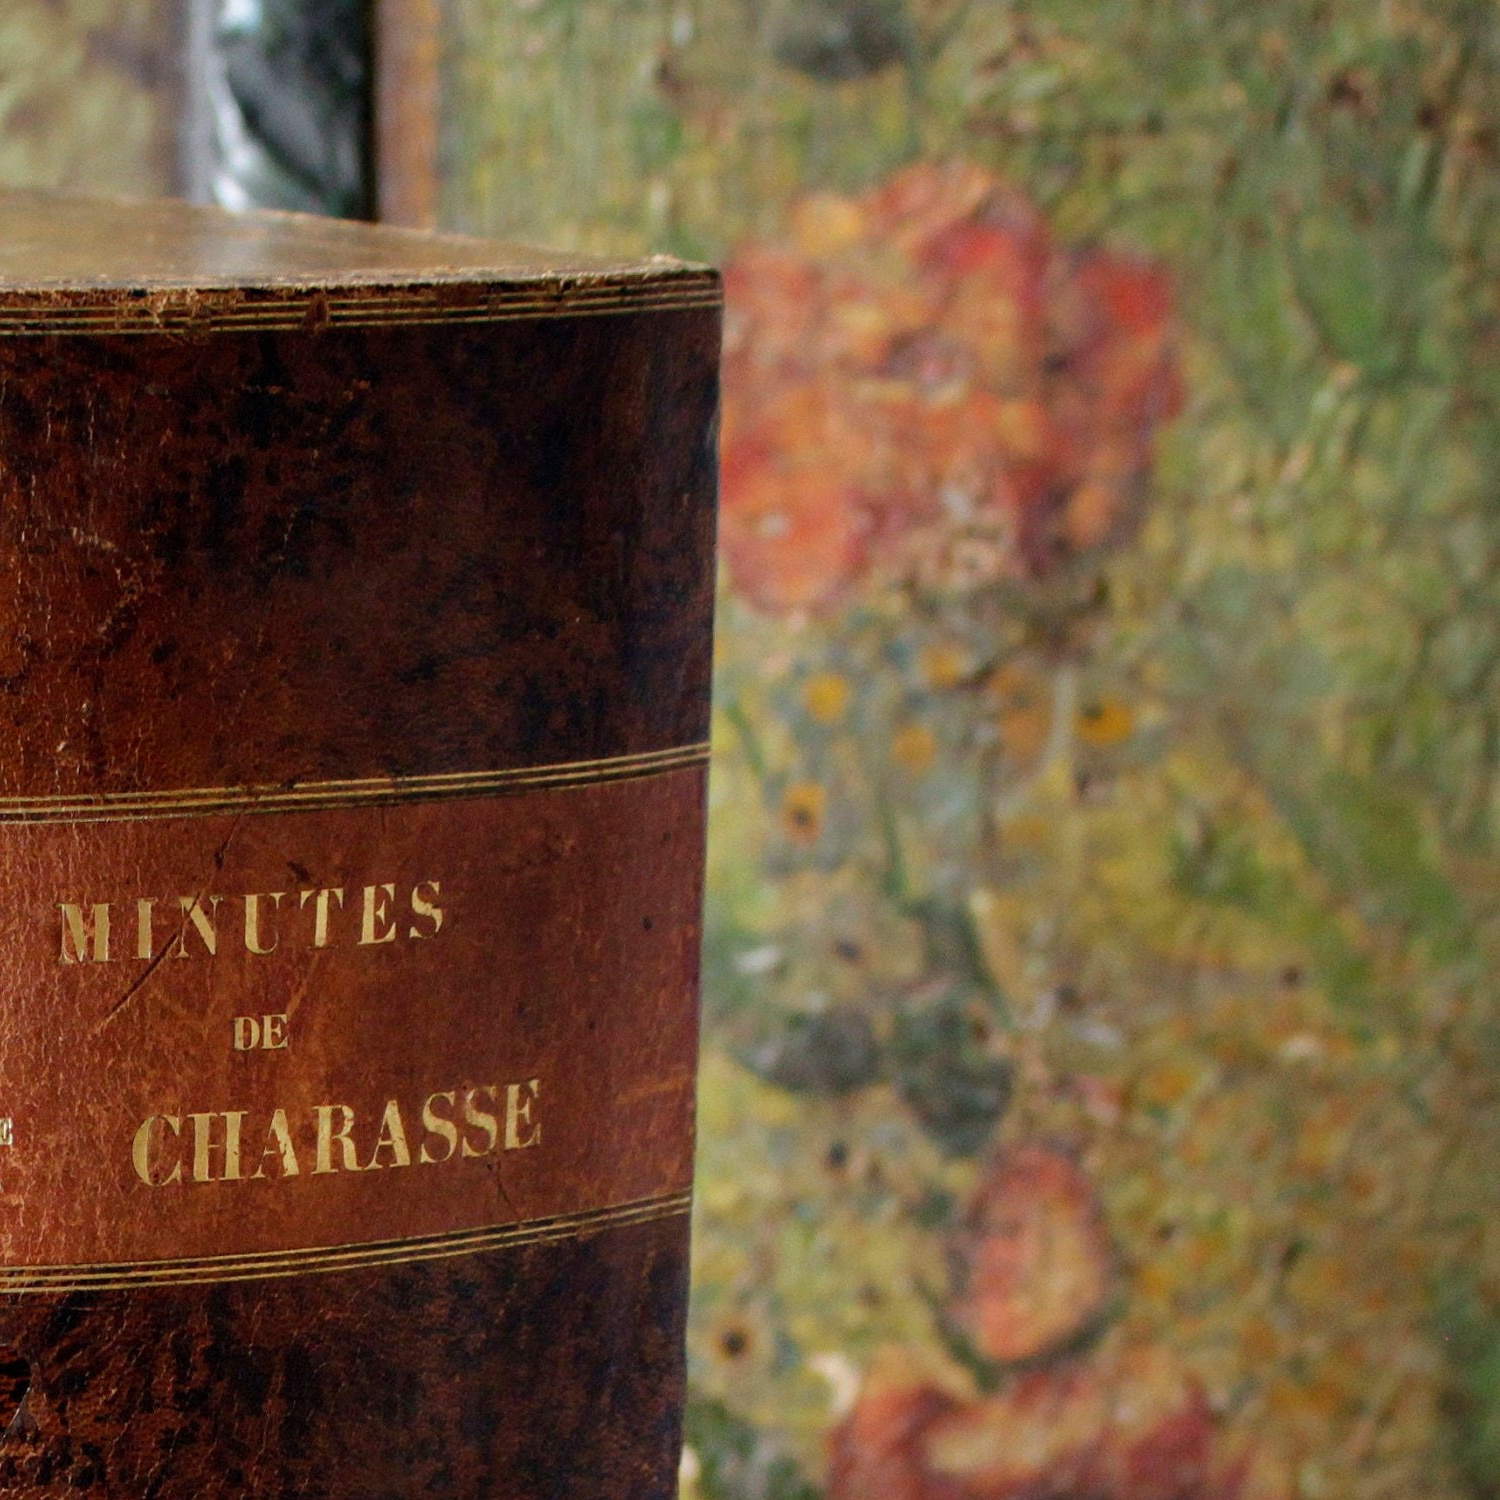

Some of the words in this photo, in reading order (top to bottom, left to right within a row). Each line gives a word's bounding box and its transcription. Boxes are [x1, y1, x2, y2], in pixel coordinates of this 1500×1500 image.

[56, 879, 444, 965] MINUTES
[232, 1013, 290, 1052] DE
[131, 1078, 542, 1189] CHARASSE
